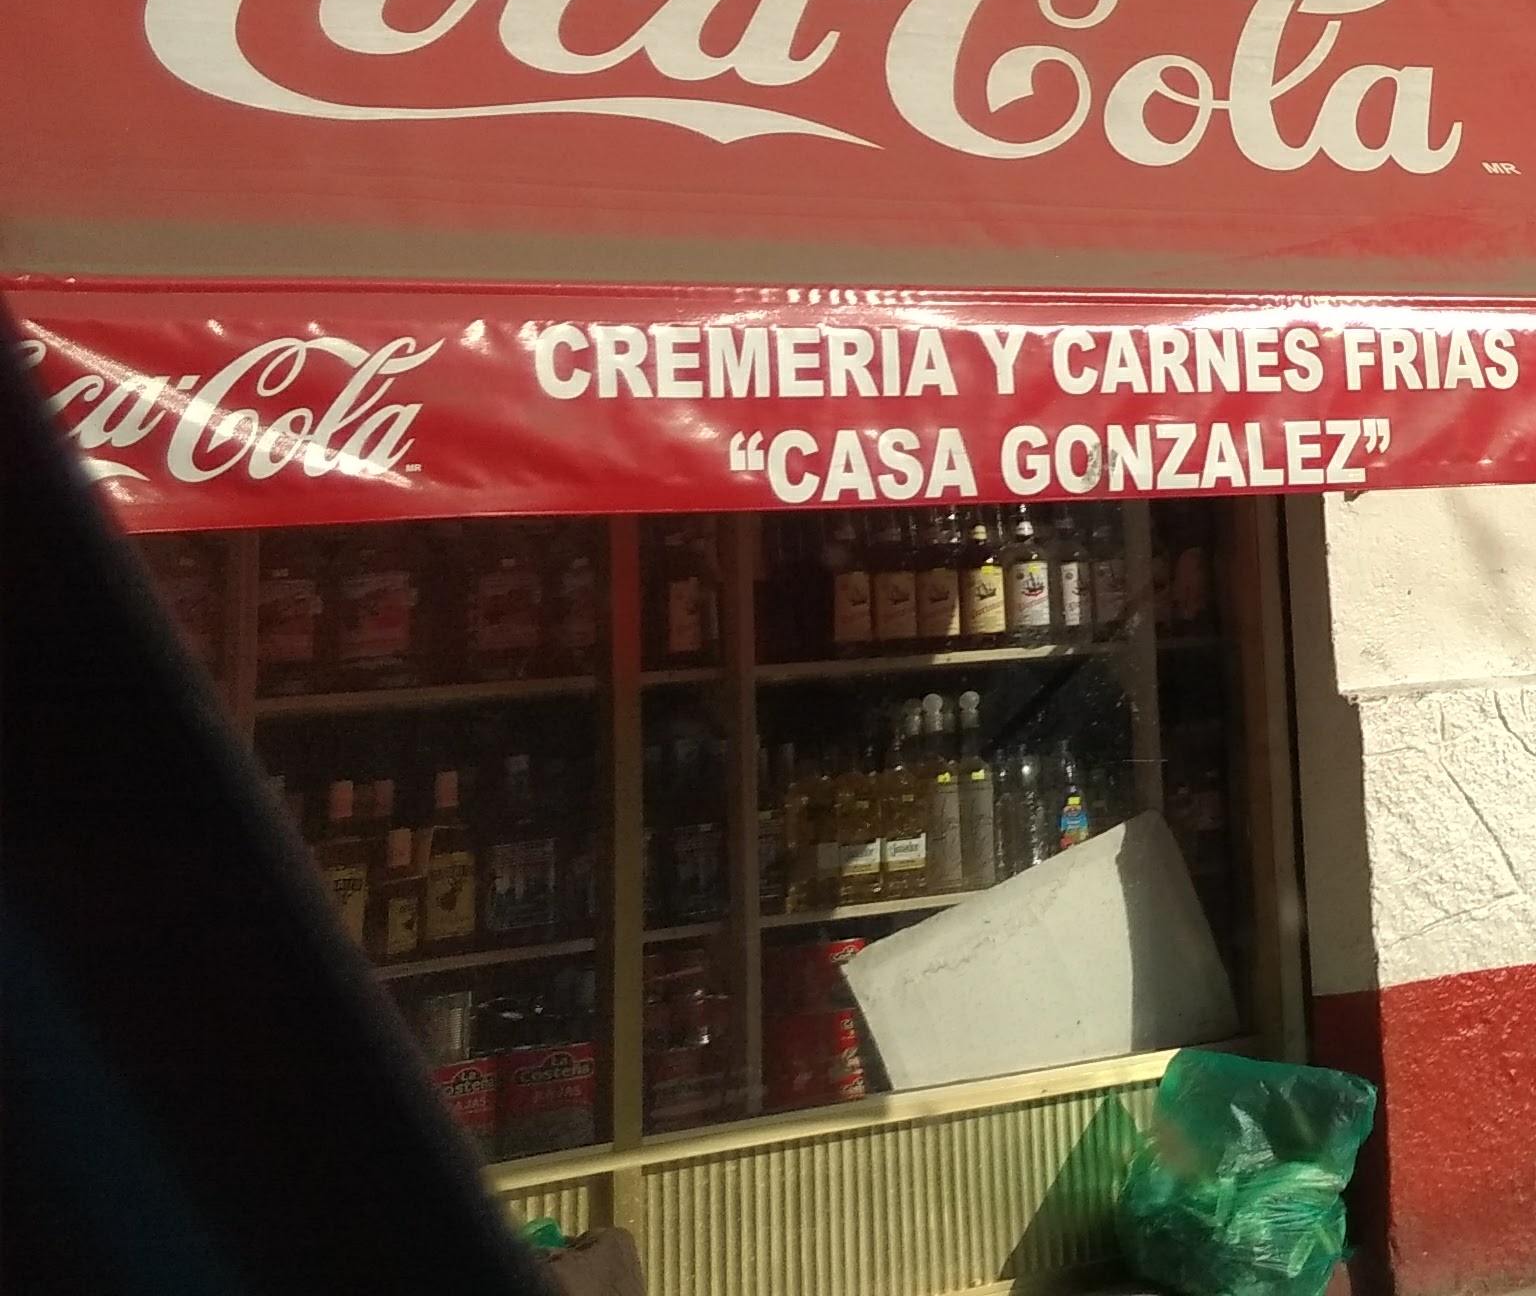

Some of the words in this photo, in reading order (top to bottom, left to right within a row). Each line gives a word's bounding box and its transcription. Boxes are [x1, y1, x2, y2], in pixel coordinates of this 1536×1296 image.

[534, 323, 959, 400] CREMERIA
[980, 324, 1025, 395] Y
[1052, 326, 1324, 395] CARNES
[1344, 325, 1519, 392] FRIAS
